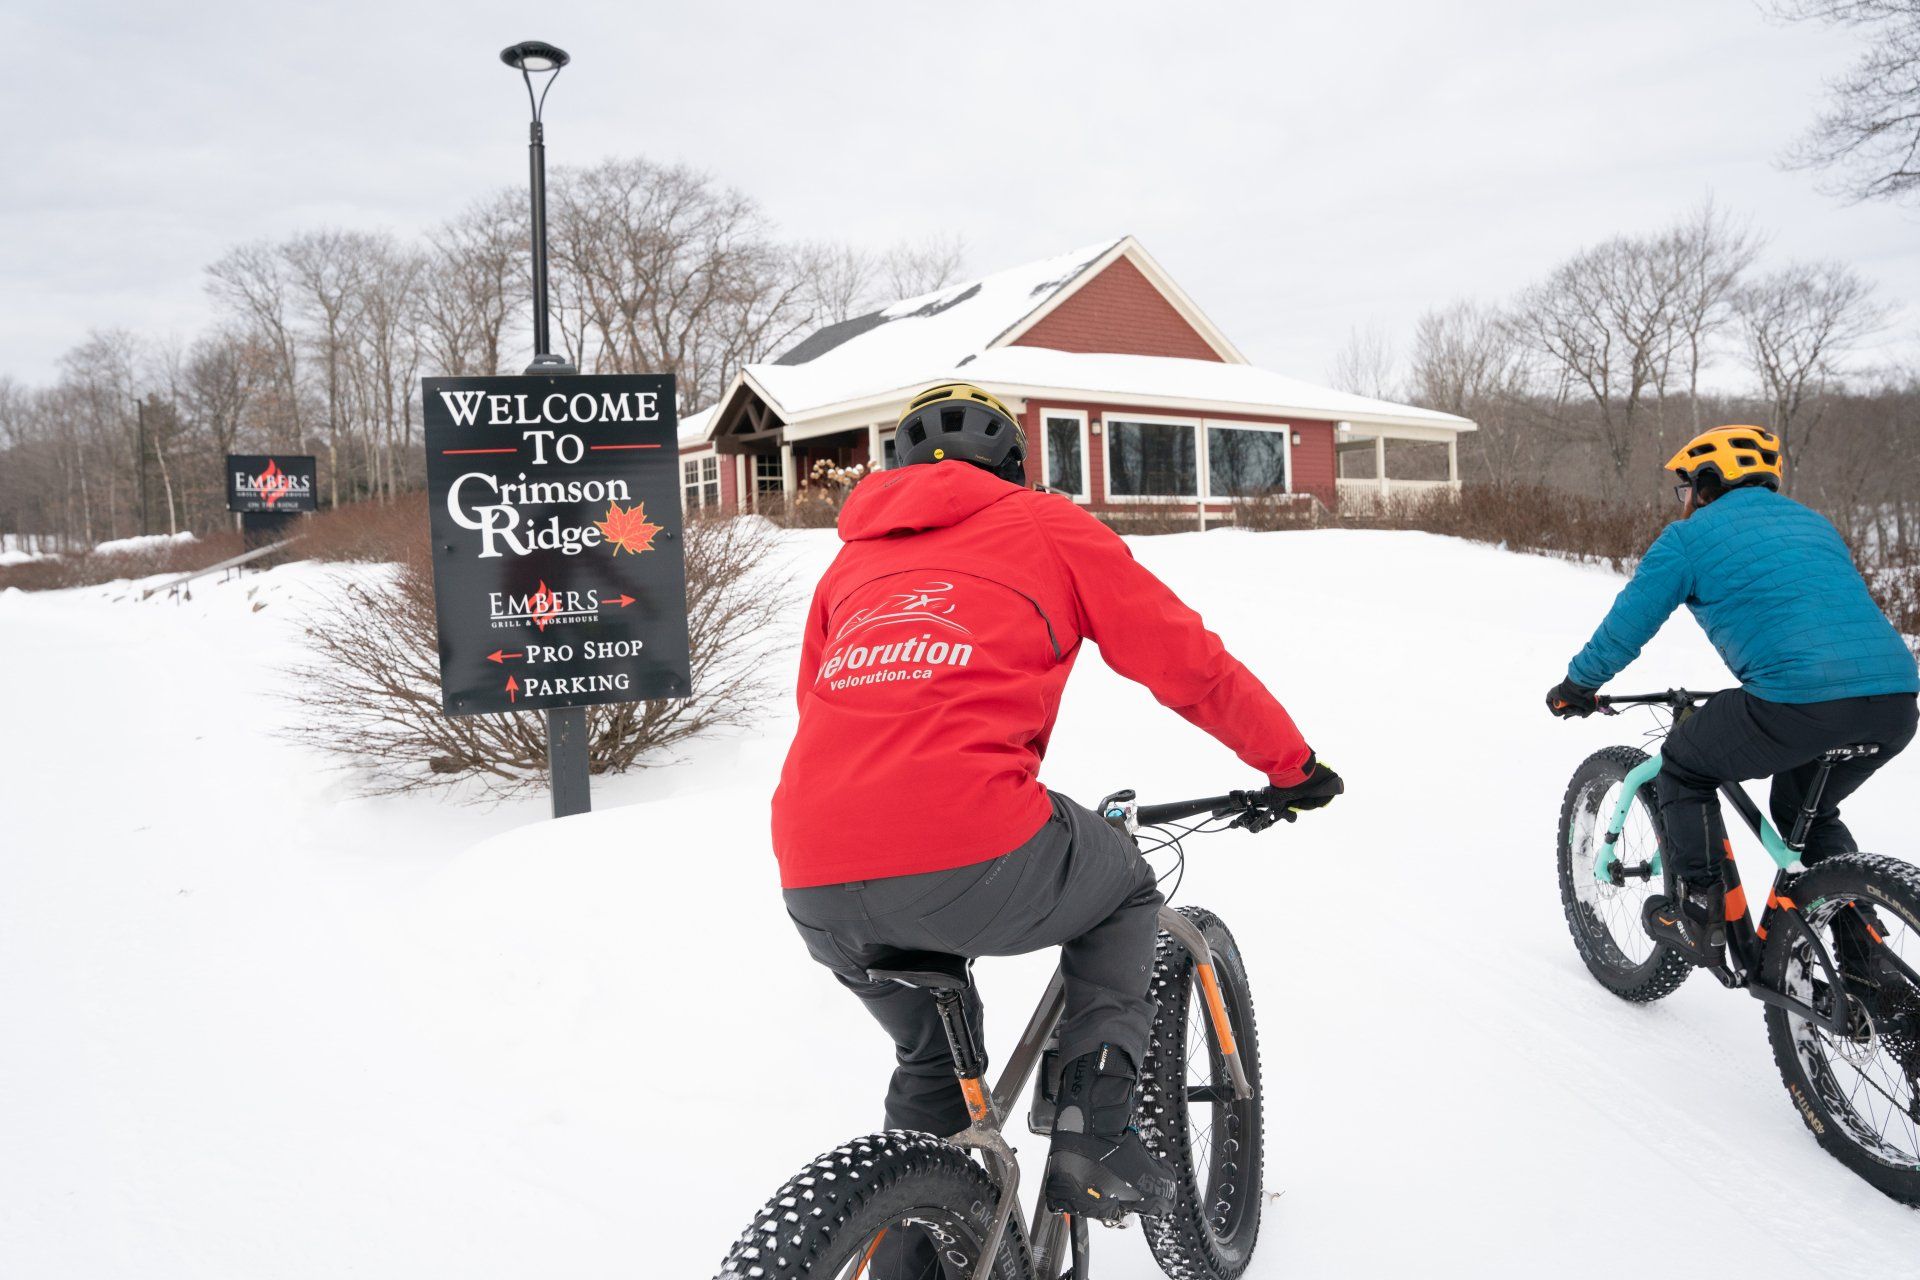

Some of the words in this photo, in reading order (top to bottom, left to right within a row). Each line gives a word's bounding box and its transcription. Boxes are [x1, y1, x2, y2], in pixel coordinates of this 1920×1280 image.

[440, 390, 660, 427] WELCOME
[523, 430, 585, 465] TO
[235, 471, 310, 489] EMBERS
[447, 472, 631, 530] Crimson
[472, 504, 601, 559] Ridge
[488, 589, 599, 617] EMBERS
[491, 620, 521, 629] GRILL
[536, 615, 599, 626] SMOKEHOUSE
[525, 645, 574, 664] PRO
[583, 640, 643, 660] SHOP
[523, 673, 630, 698] PARKING
[830, 667, 933, 692] velorution.ca
[970, 1199, 994, 1232] CAK
